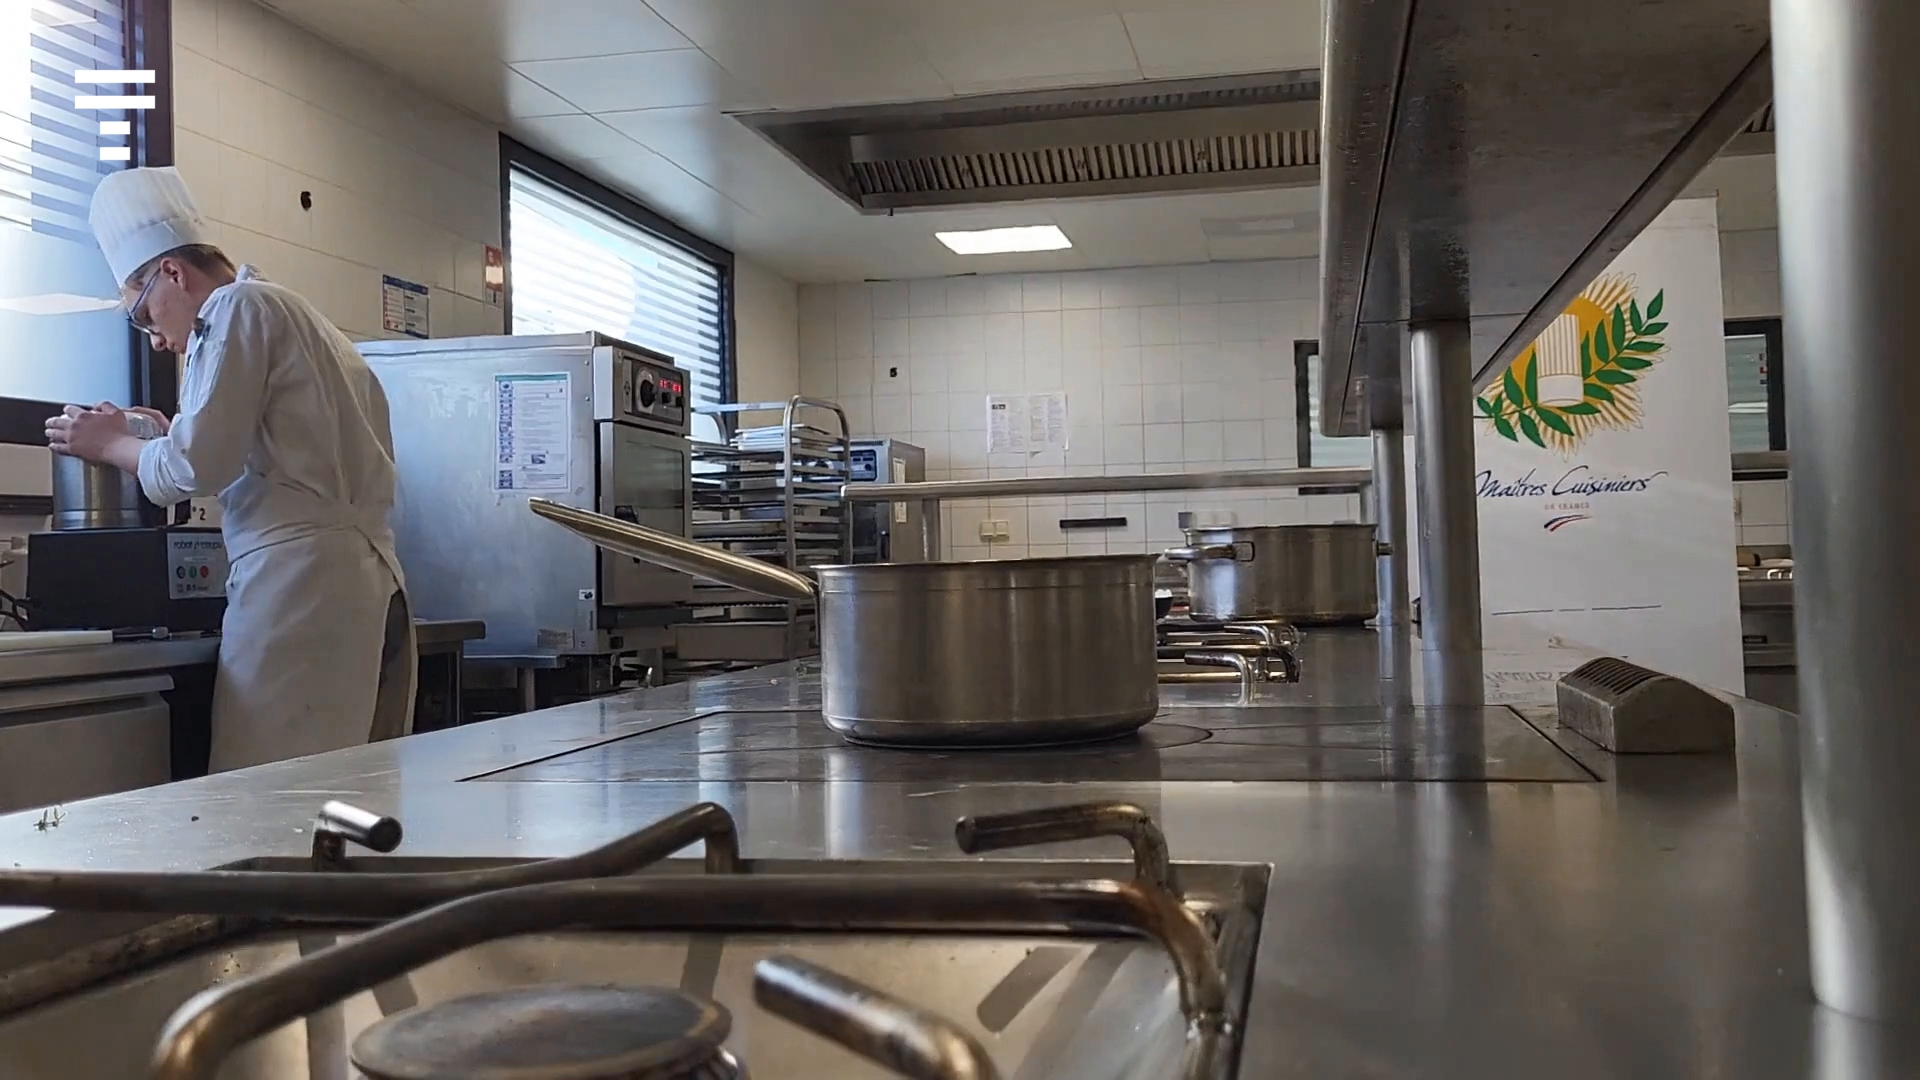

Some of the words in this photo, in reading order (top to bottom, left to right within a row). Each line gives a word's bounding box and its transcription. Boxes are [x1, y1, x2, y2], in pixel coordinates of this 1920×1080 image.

[1475, 468, 1548, 498] Maîtres
[1551, 465, 1669, 496] Cuisiniers
[199, 508, 206, 521] 2
